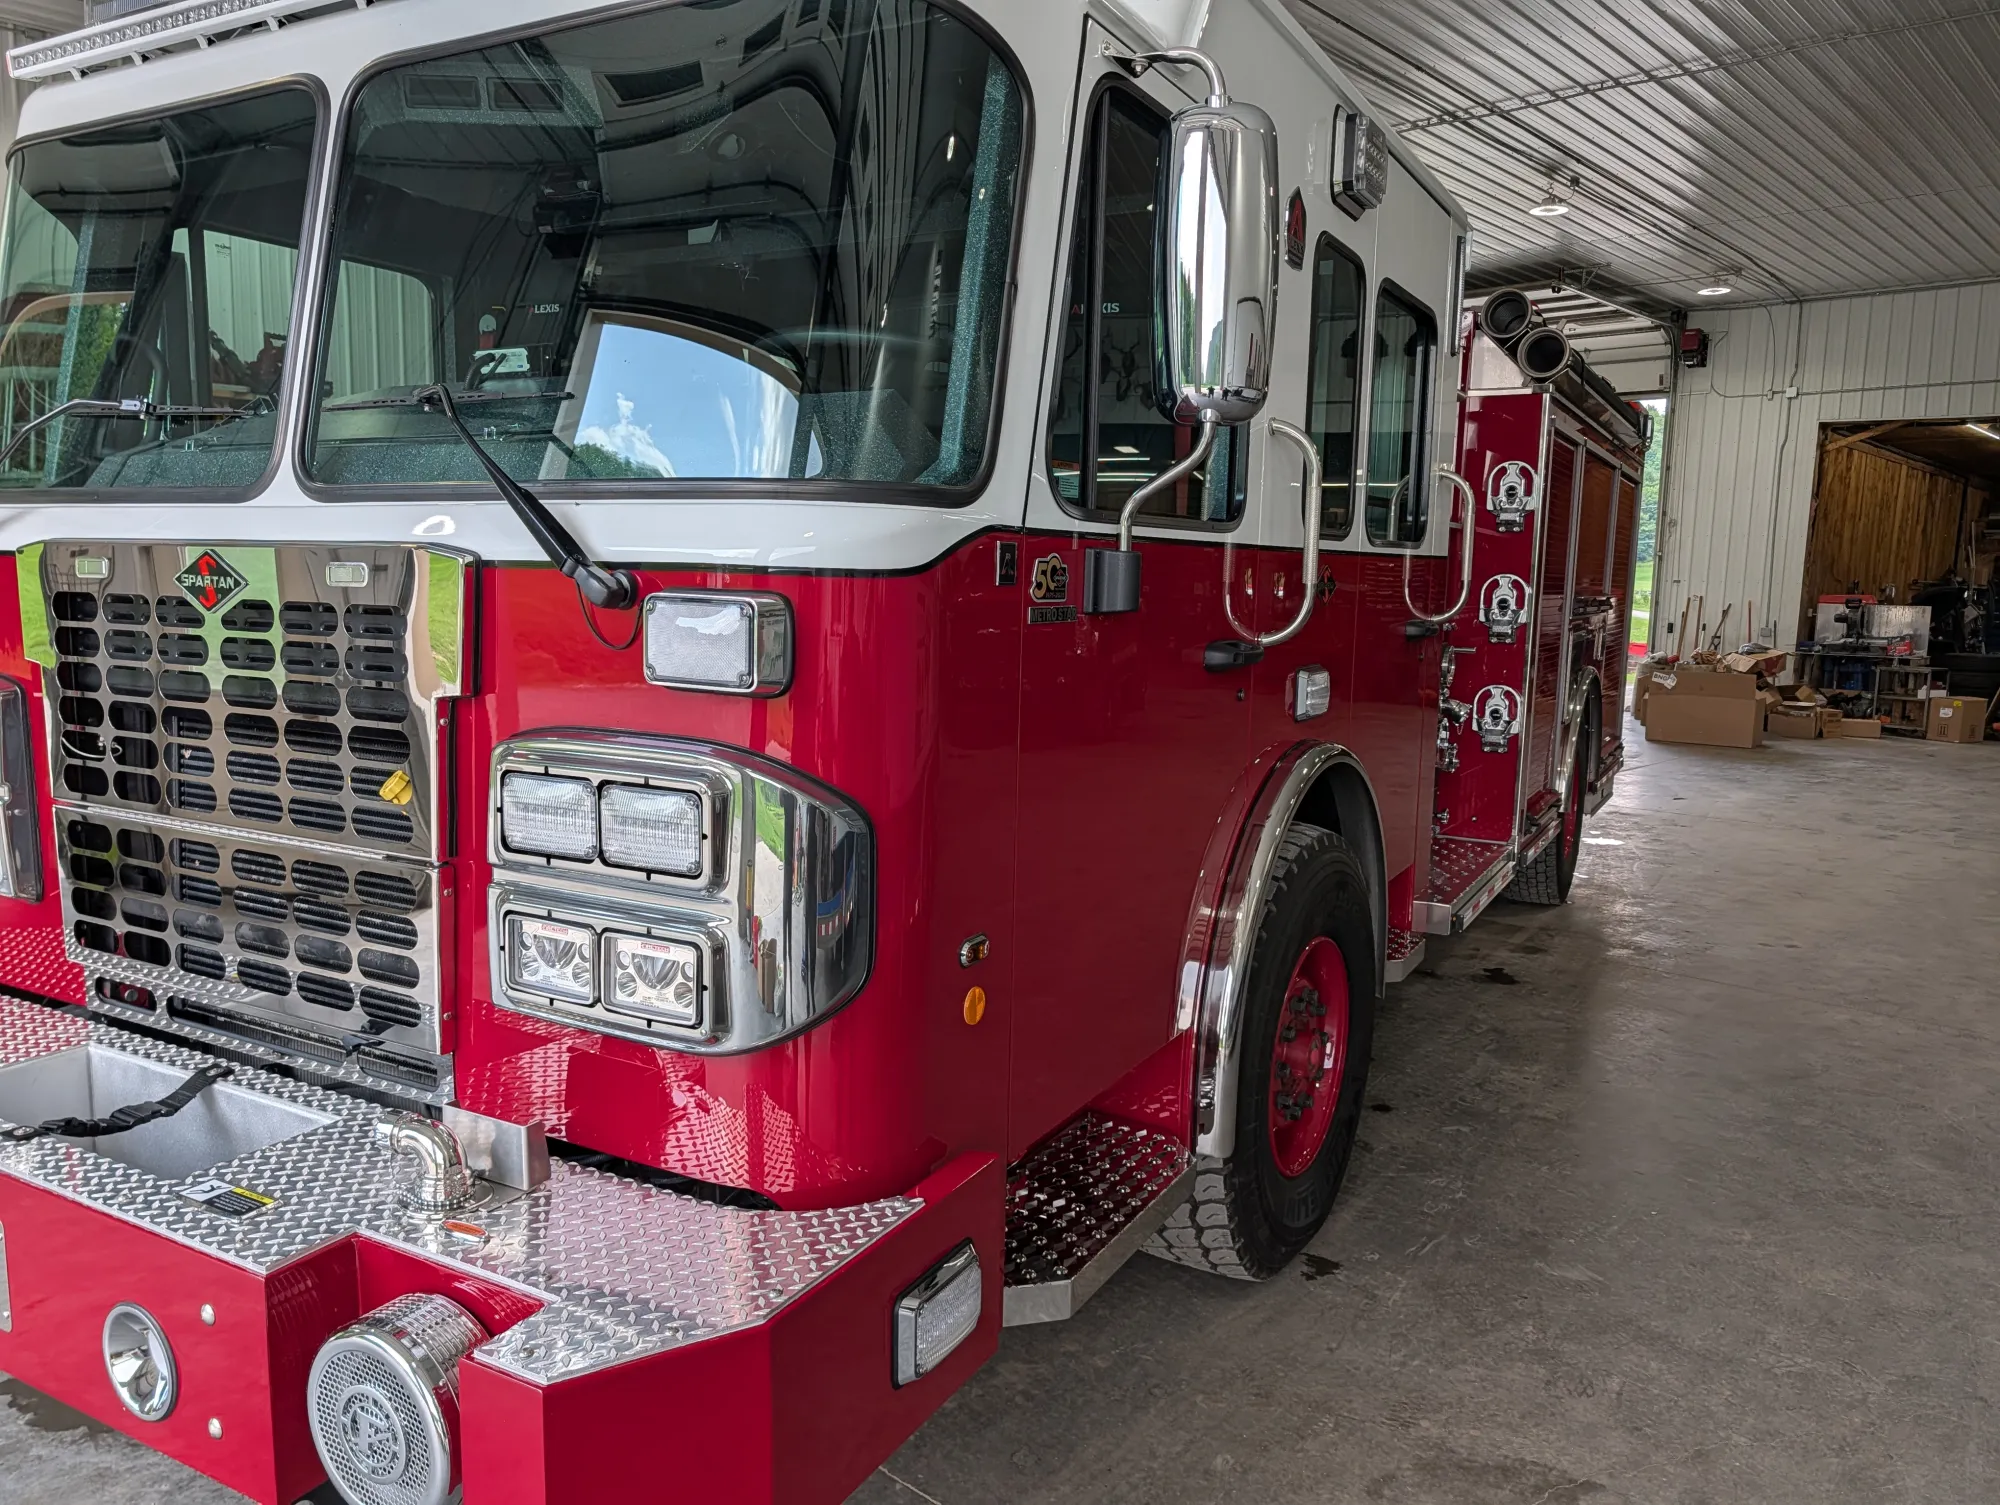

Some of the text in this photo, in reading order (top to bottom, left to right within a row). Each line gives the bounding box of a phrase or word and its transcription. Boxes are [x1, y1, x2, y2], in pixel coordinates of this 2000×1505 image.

[528, 304, 560, 313] LEXIS
[181, 574, 235, 589] SPARTAN
[1030, 607, 1077, 622] METRO STAR
